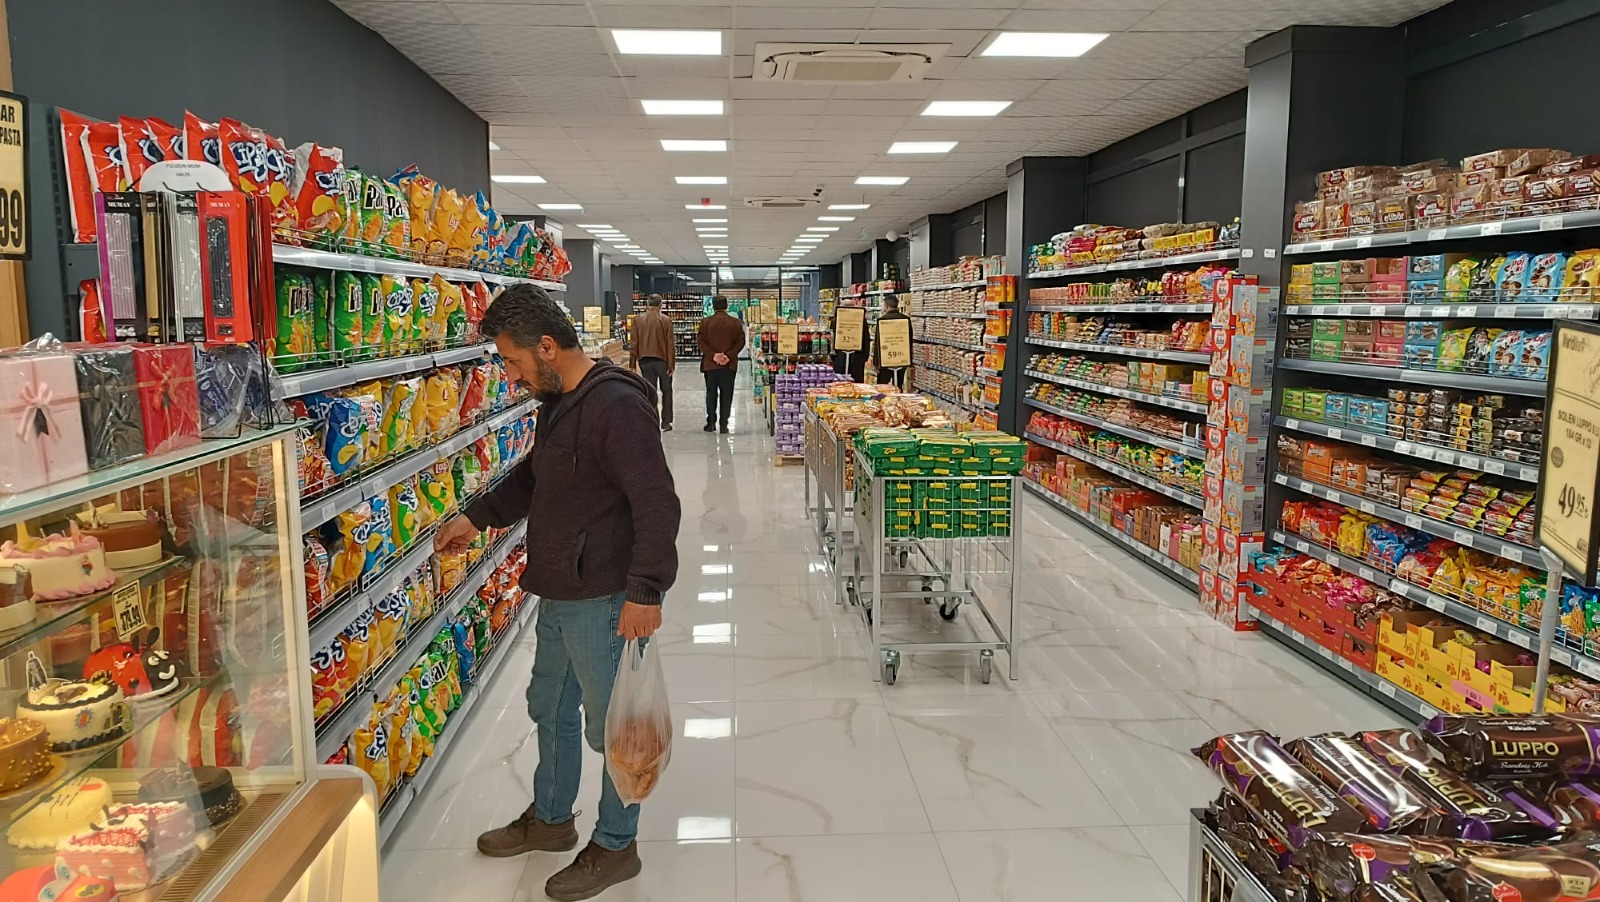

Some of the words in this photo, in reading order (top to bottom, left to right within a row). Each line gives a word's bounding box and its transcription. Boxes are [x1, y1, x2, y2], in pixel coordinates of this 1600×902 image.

[0, 127, 21, 147] PASTA
[1558, 482, 1576, 518] 49
[1489, 740, 1560, 757] LUPPO
[1262, 774, 1327, 829] LUPPO
